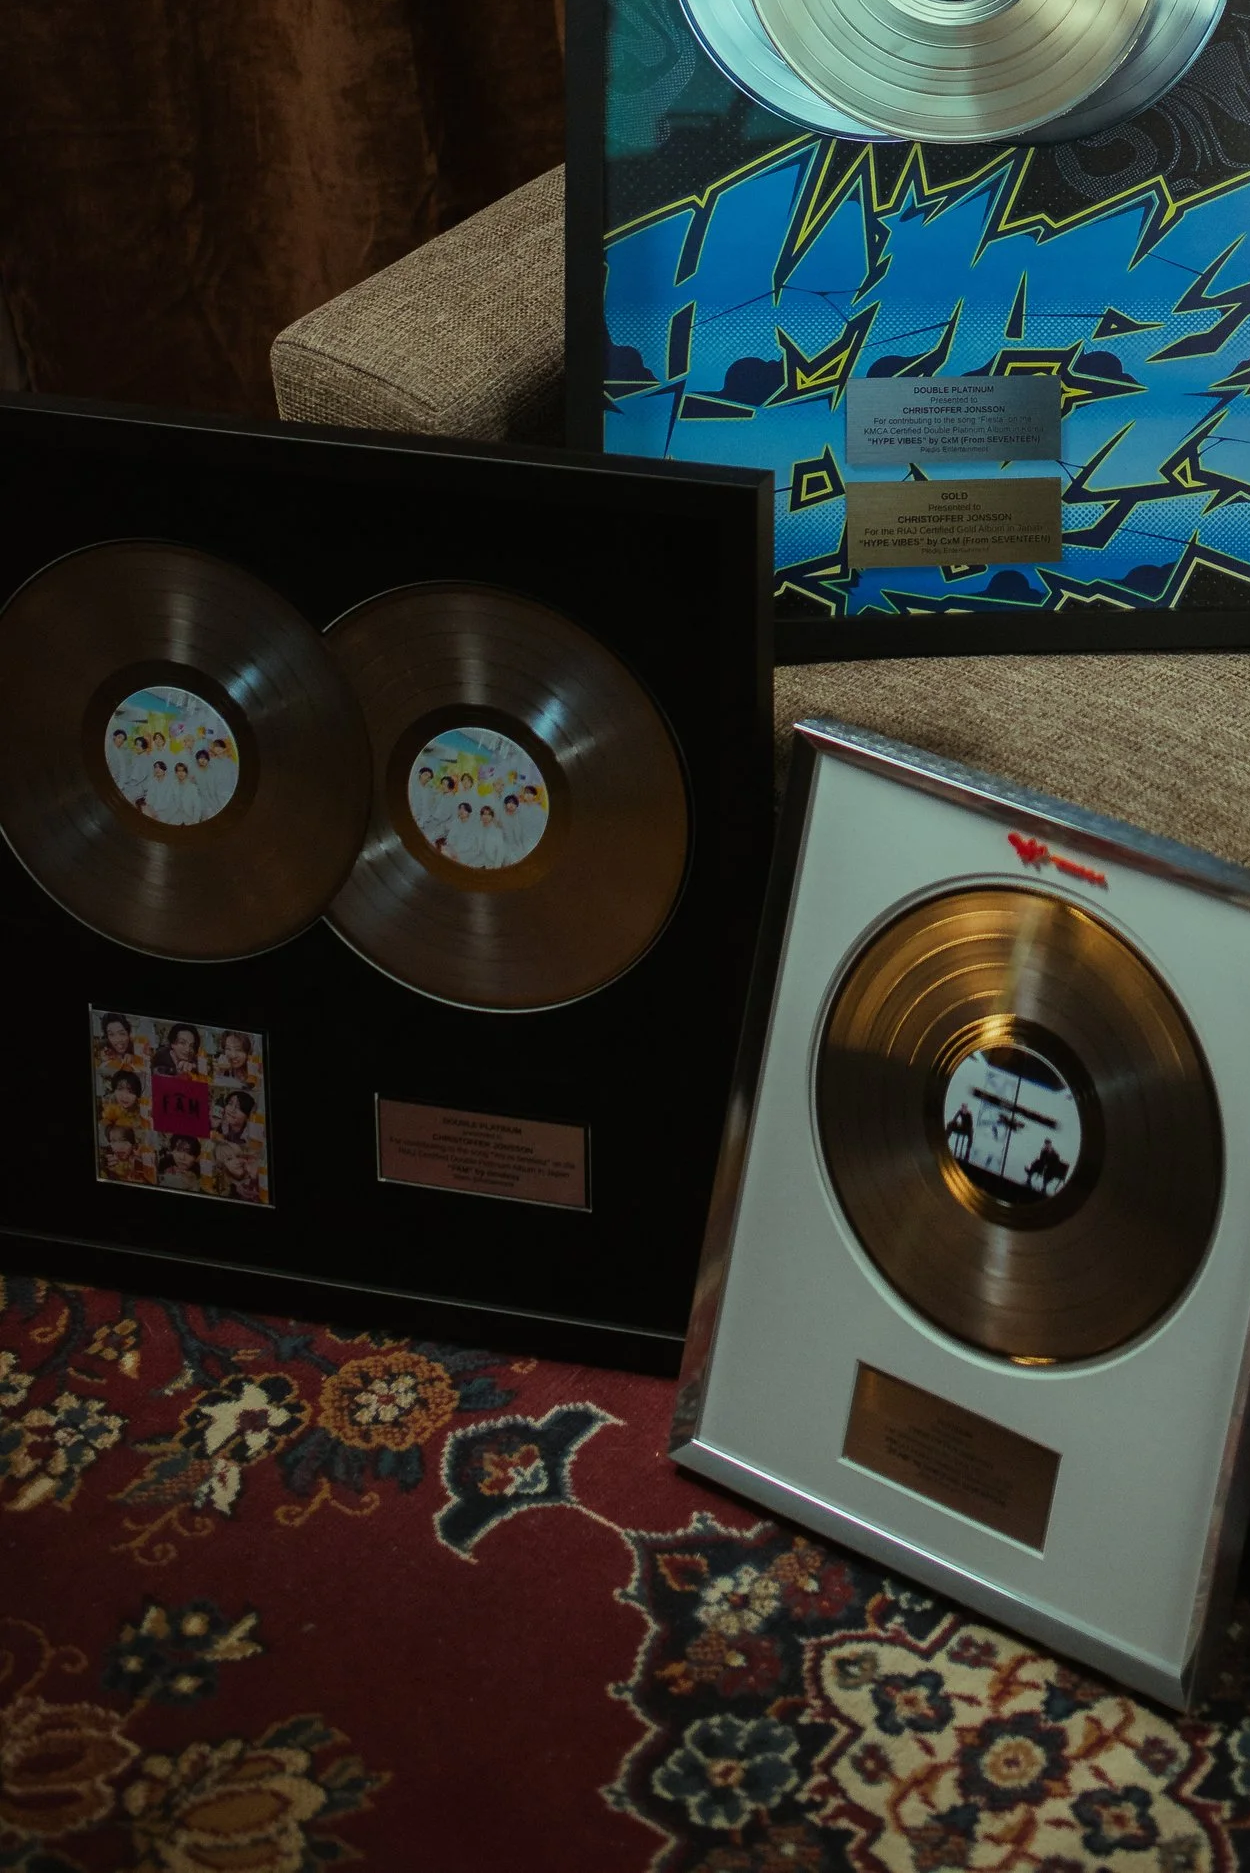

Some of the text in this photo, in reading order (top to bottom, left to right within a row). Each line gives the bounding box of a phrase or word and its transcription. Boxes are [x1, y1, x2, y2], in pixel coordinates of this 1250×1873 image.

[914, 386, 949, 394] DOUBLE
[930, 396, 968, 404] Presented
[874, 417, 887, 425] For
[889, 417, 932, 425] contributing
[958, 417, 976, 425] song
[929, 437, 939, 445] by
[961, 436, 985, 444] (From
[987, 435, 1040, 443] SEVENTEEN)
[941, 492, 968, 500] GOLD
[928, 503, 970, 512] Presented
[898, 513, 1012, 524] CHRISTOFFER JONSSON
[919, 526, 954, 534] Certified
[957, 525, 976, 533] Gold
[927, 538, 938, 546] by
[940, 537, 960, 545] CxM
[963, 536, 988, 545] (From
[991, 535, 1050, 544] SEVENTEEN)
[432, 1133, 534, 1154] CHRISTOFFER JONSSON
